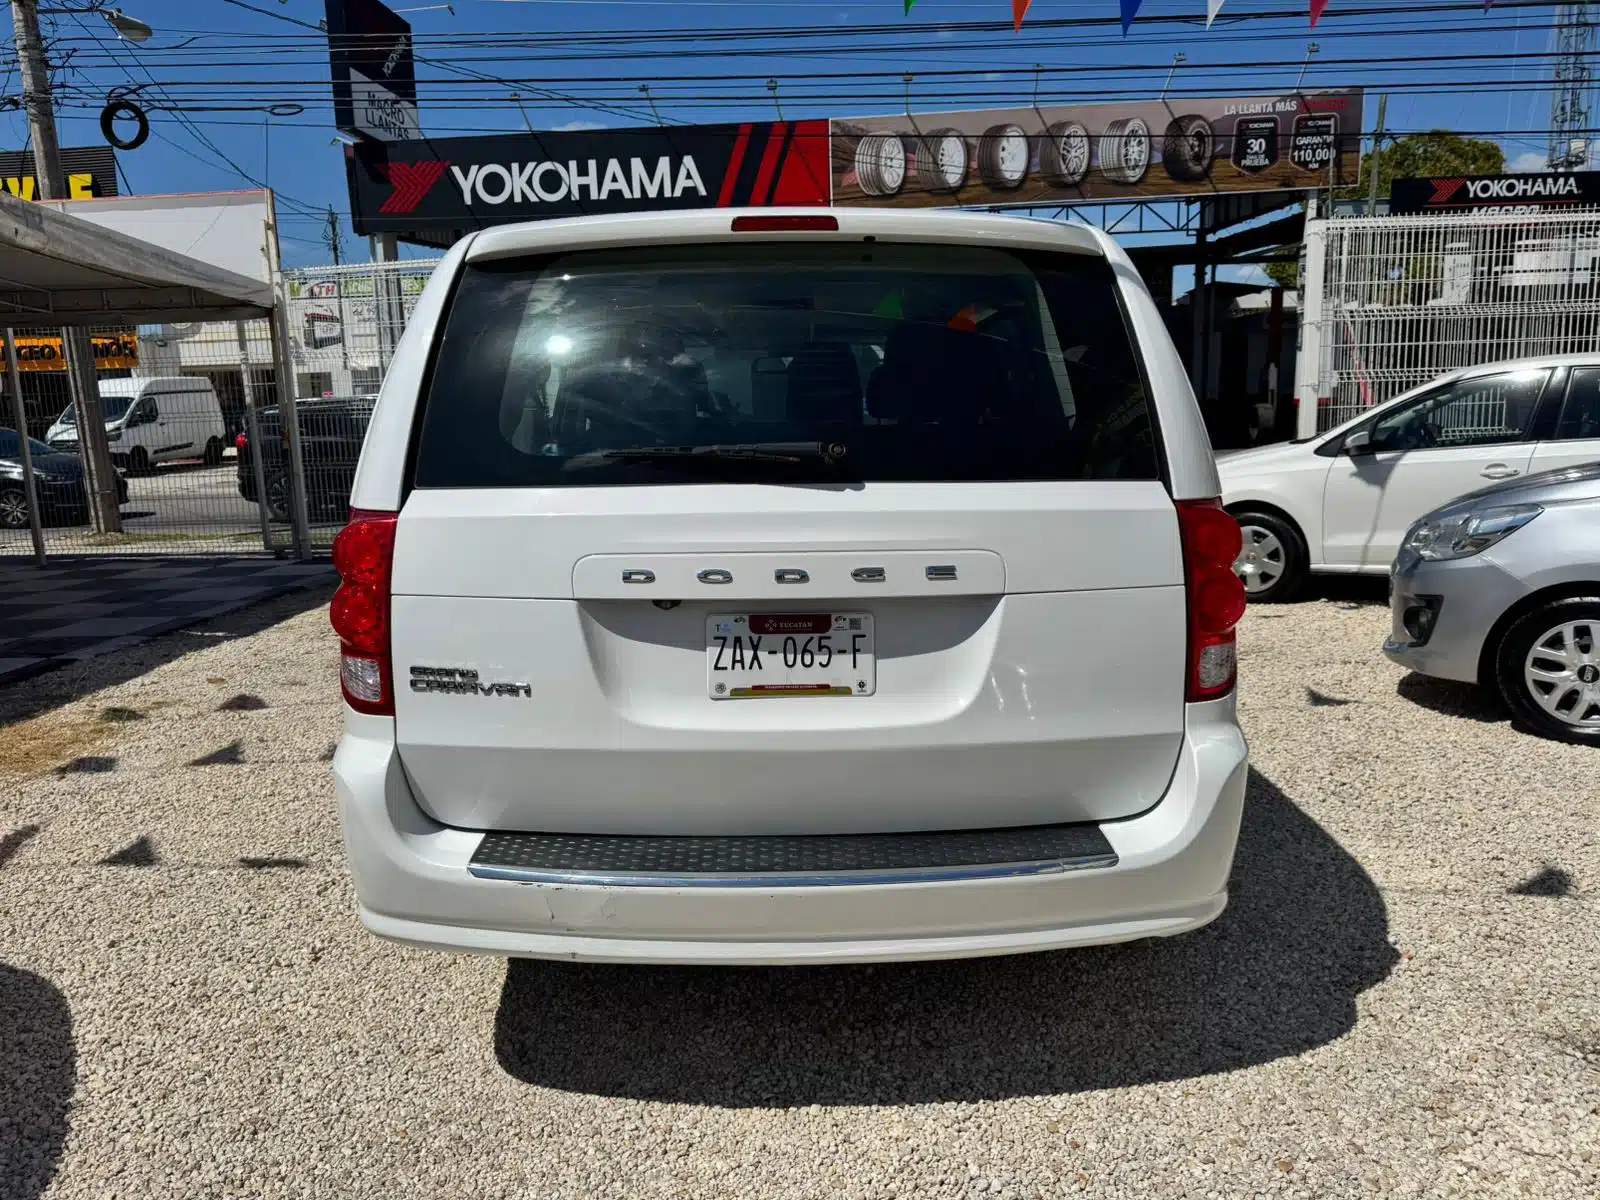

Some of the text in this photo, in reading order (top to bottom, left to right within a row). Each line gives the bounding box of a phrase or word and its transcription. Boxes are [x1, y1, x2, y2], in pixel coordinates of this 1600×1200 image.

[367, 91, 405, 125] MACRO
[1224, 105, 1237, 115] LA
[1239, 102, 1274, 114] LLANTA
[1275, 99, 1297, 112] MÁS
[365, 107, 410, 140] LLANTAS
[1246, 138, 1267, 154] 30
[1240, 157, 1270, 167] PRUEBA
[450, 155, 707, 206] YOKOHAMA
[1466, 177, 1578, 198] YOKOHAMA
[622, 565, 958, 584] DODGE
[713, 635, 867, 670] ZAX-065-F
